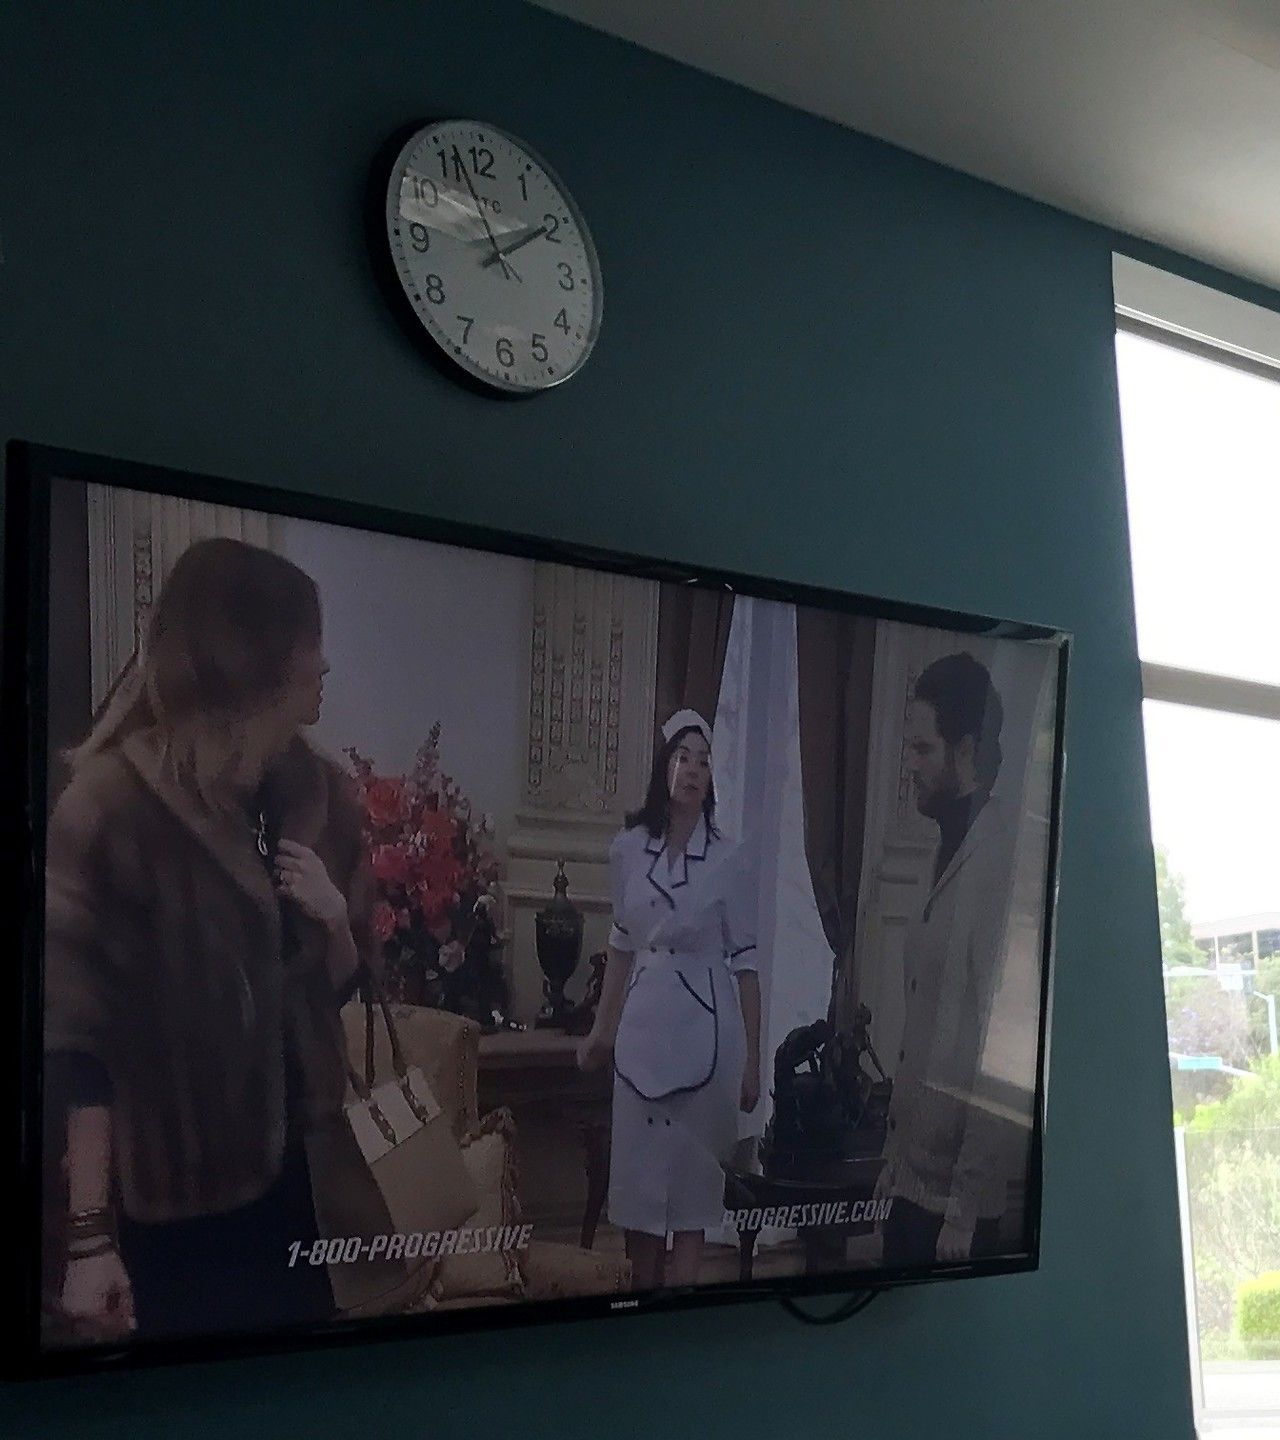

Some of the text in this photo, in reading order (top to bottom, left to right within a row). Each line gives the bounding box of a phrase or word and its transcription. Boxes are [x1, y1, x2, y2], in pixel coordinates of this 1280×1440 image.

[437, 149, 463, 182] 11
[469, 147, 496, 180] 12
[411, 176, 439, 208] 10
[517, 173, 528, 201] 1
[409, 222, 430, 253] 9
[543, 213, 562, 244] 2
[425, 274, 447, 305] 8
[556, 262, 575, 292] 3
[456, 315, 475, 345] 7
[554, 308, 571, 336] 4
[495, 337, 515, 368] 6
[531, 333, 549, 363] 5
[721, 1198, 894, 1232] PROGRESSIVE.COM
[288, 1223, 535, 1268] 1-800-PROGRESSIVE
